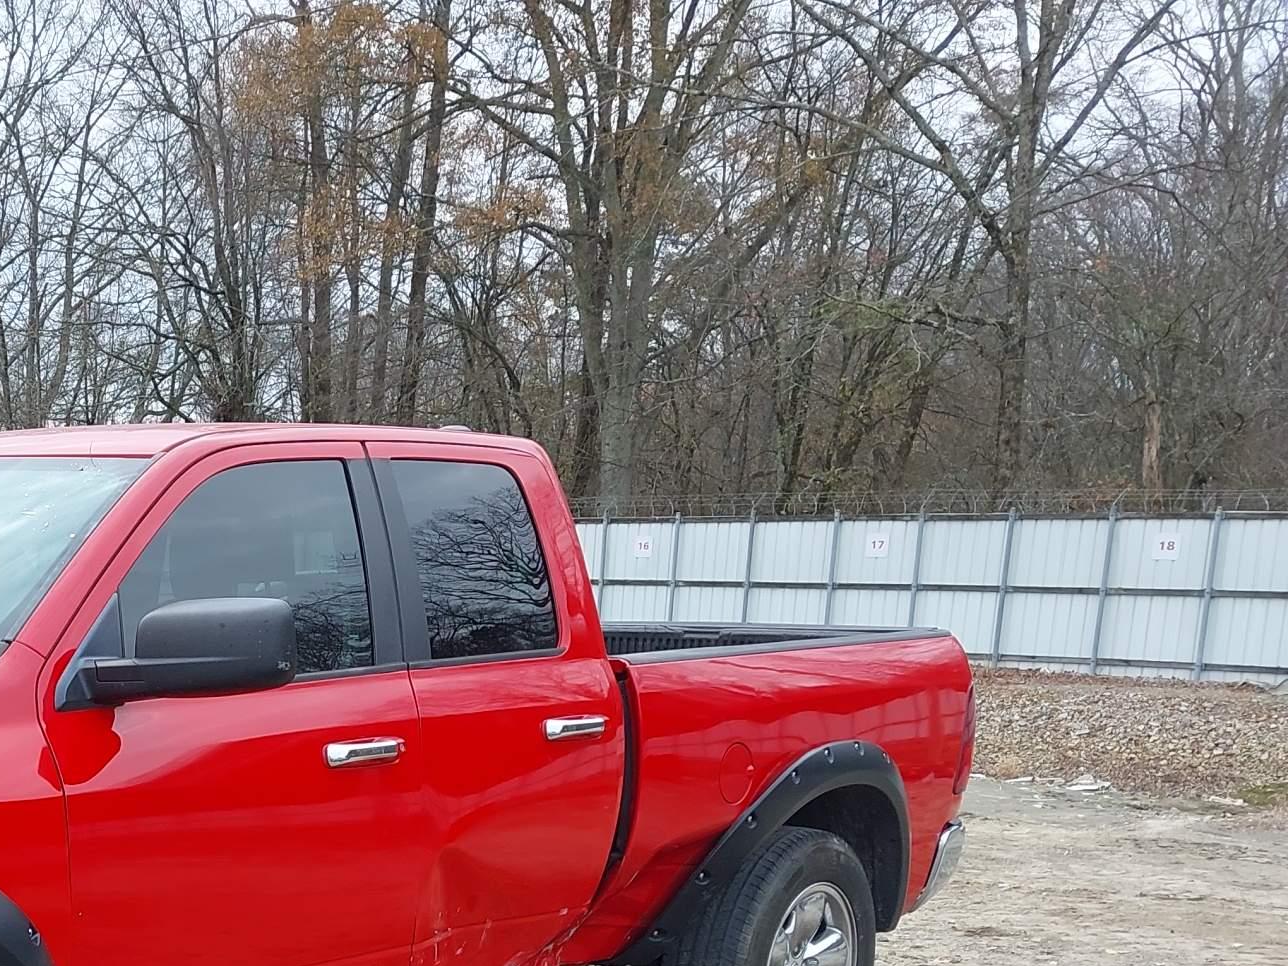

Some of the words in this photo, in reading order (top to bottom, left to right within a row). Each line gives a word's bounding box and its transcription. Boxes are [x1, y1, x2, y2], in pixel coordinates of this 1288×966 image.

[638, 542, 650, 551] 16
[871, 540, 885, 550] 17
[1159, 540, 1176, 551] 18
